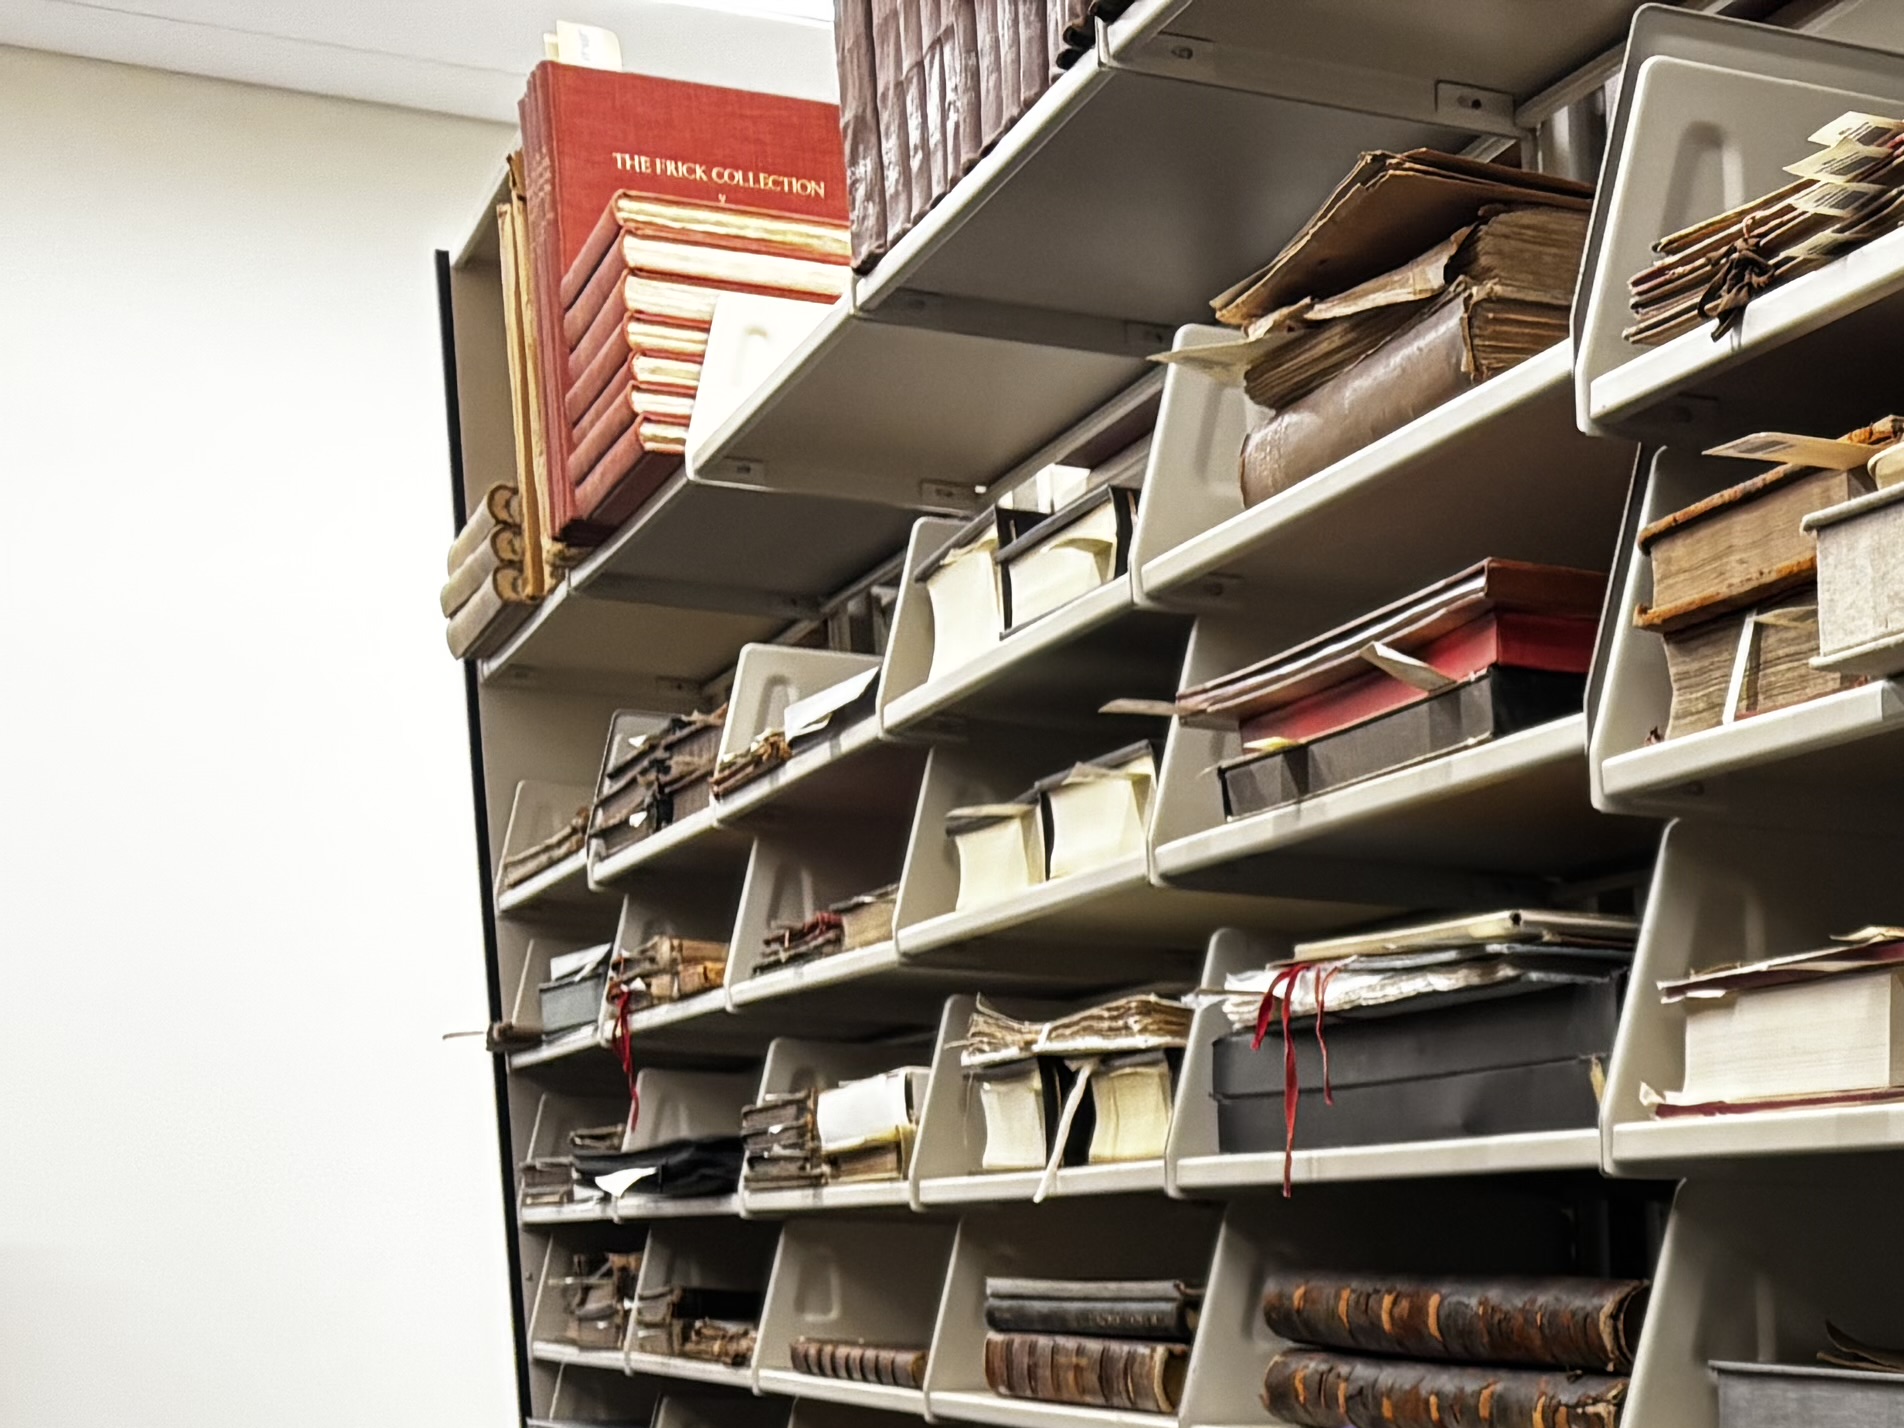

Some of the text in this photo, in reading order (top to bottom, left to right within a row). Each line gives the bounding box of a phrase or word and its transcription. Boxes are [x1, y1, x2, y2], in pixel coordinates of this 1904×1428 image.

[612, 152, 825, 199] THE FRICK COLLECTION
